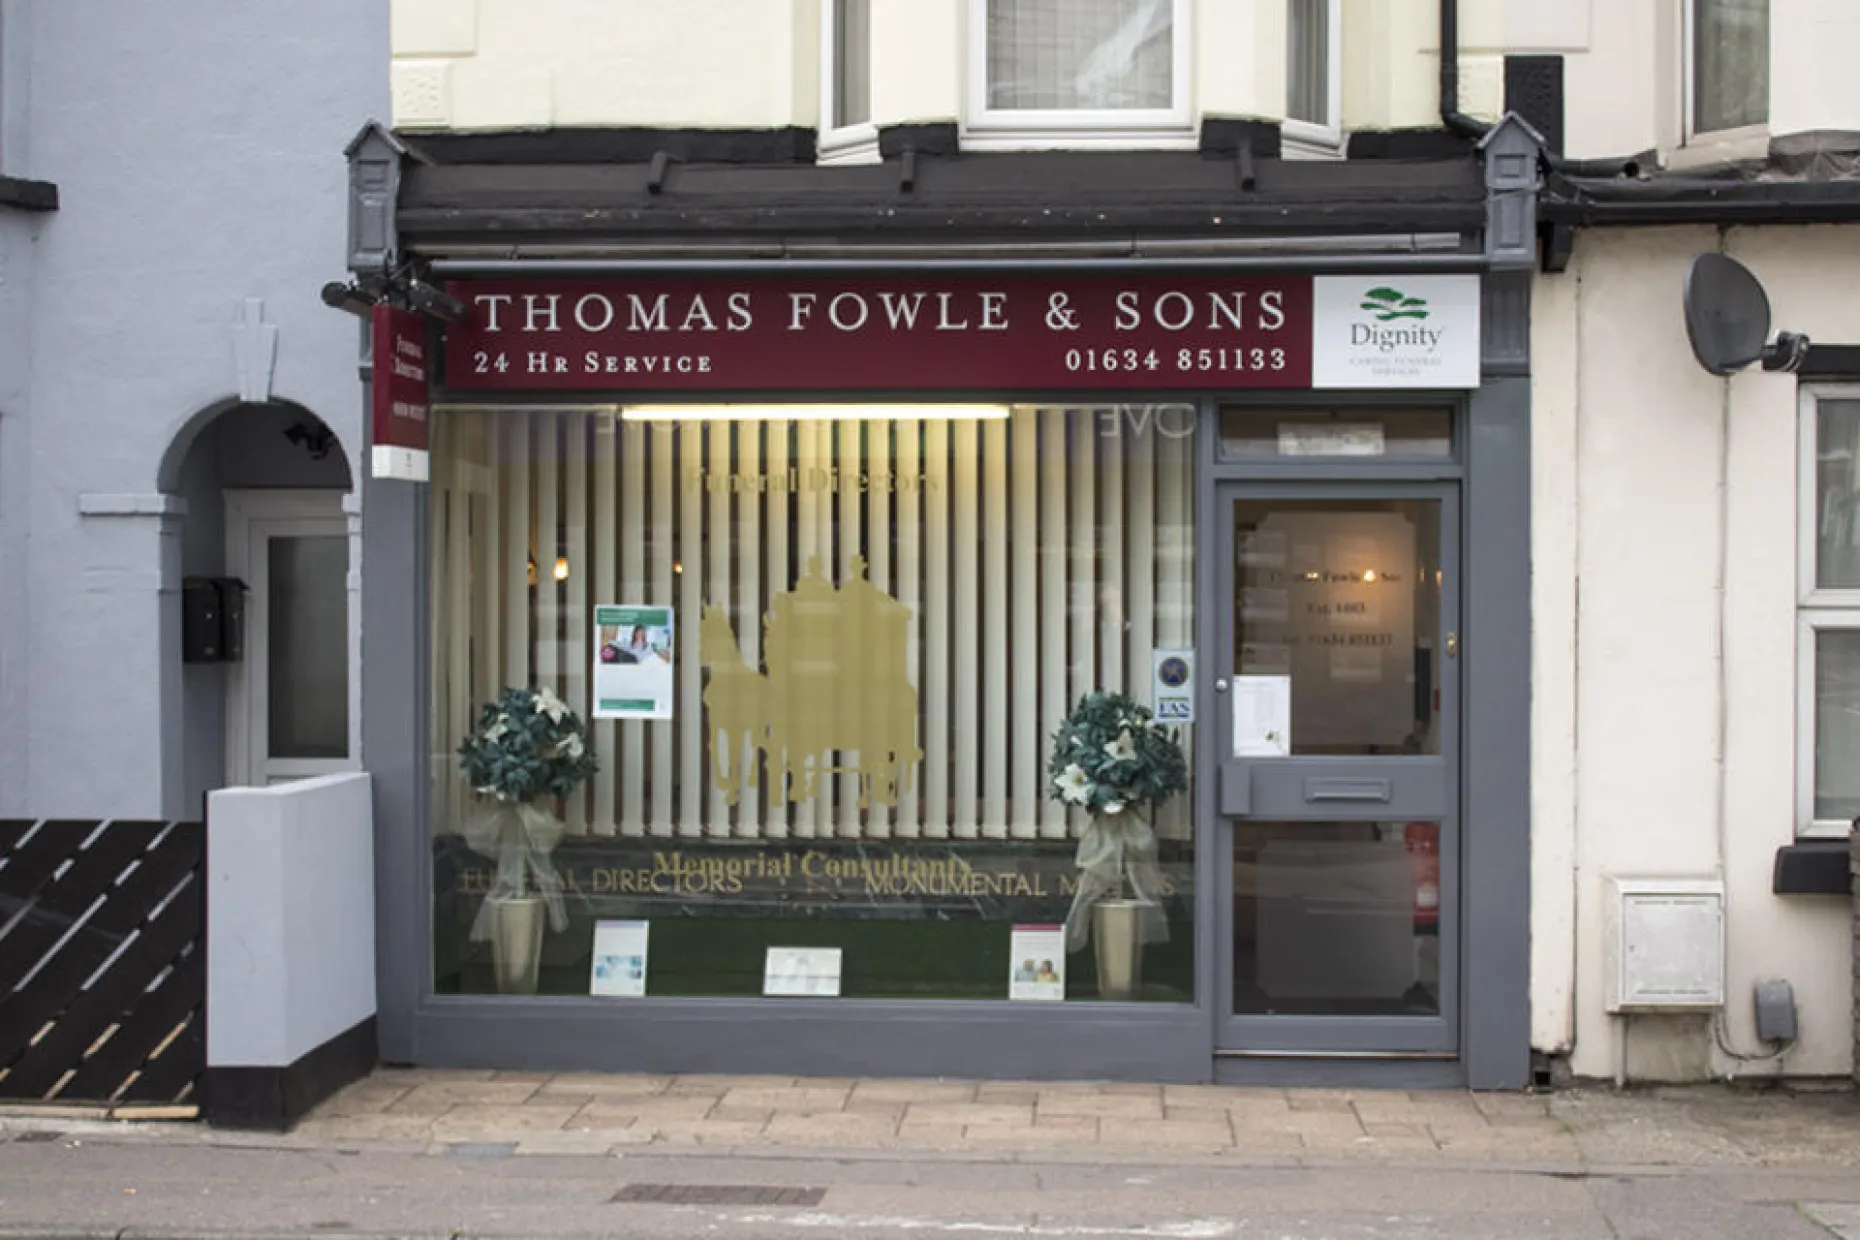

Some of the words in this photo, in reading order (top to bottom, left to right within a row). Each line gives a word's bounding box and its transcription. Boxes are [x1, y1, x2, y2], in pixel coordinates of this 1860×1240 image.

[474, 291, 754, 332] THOMAS
[788, 290, 1009, 331] FOWLE
[1045, 290, 1080, 331] &
[1115, 290, 1287, 332] SONS
[1350, 322, 1442, 352] Dignity
[474, 351, 509, 374] 24
[1066, 348, 1160, 371] 01634
[1177, 348, 1287, 371] 851133
[653, 850, 793, 877] Memorial
[592, 867, 743, 893] DIRECTORS
